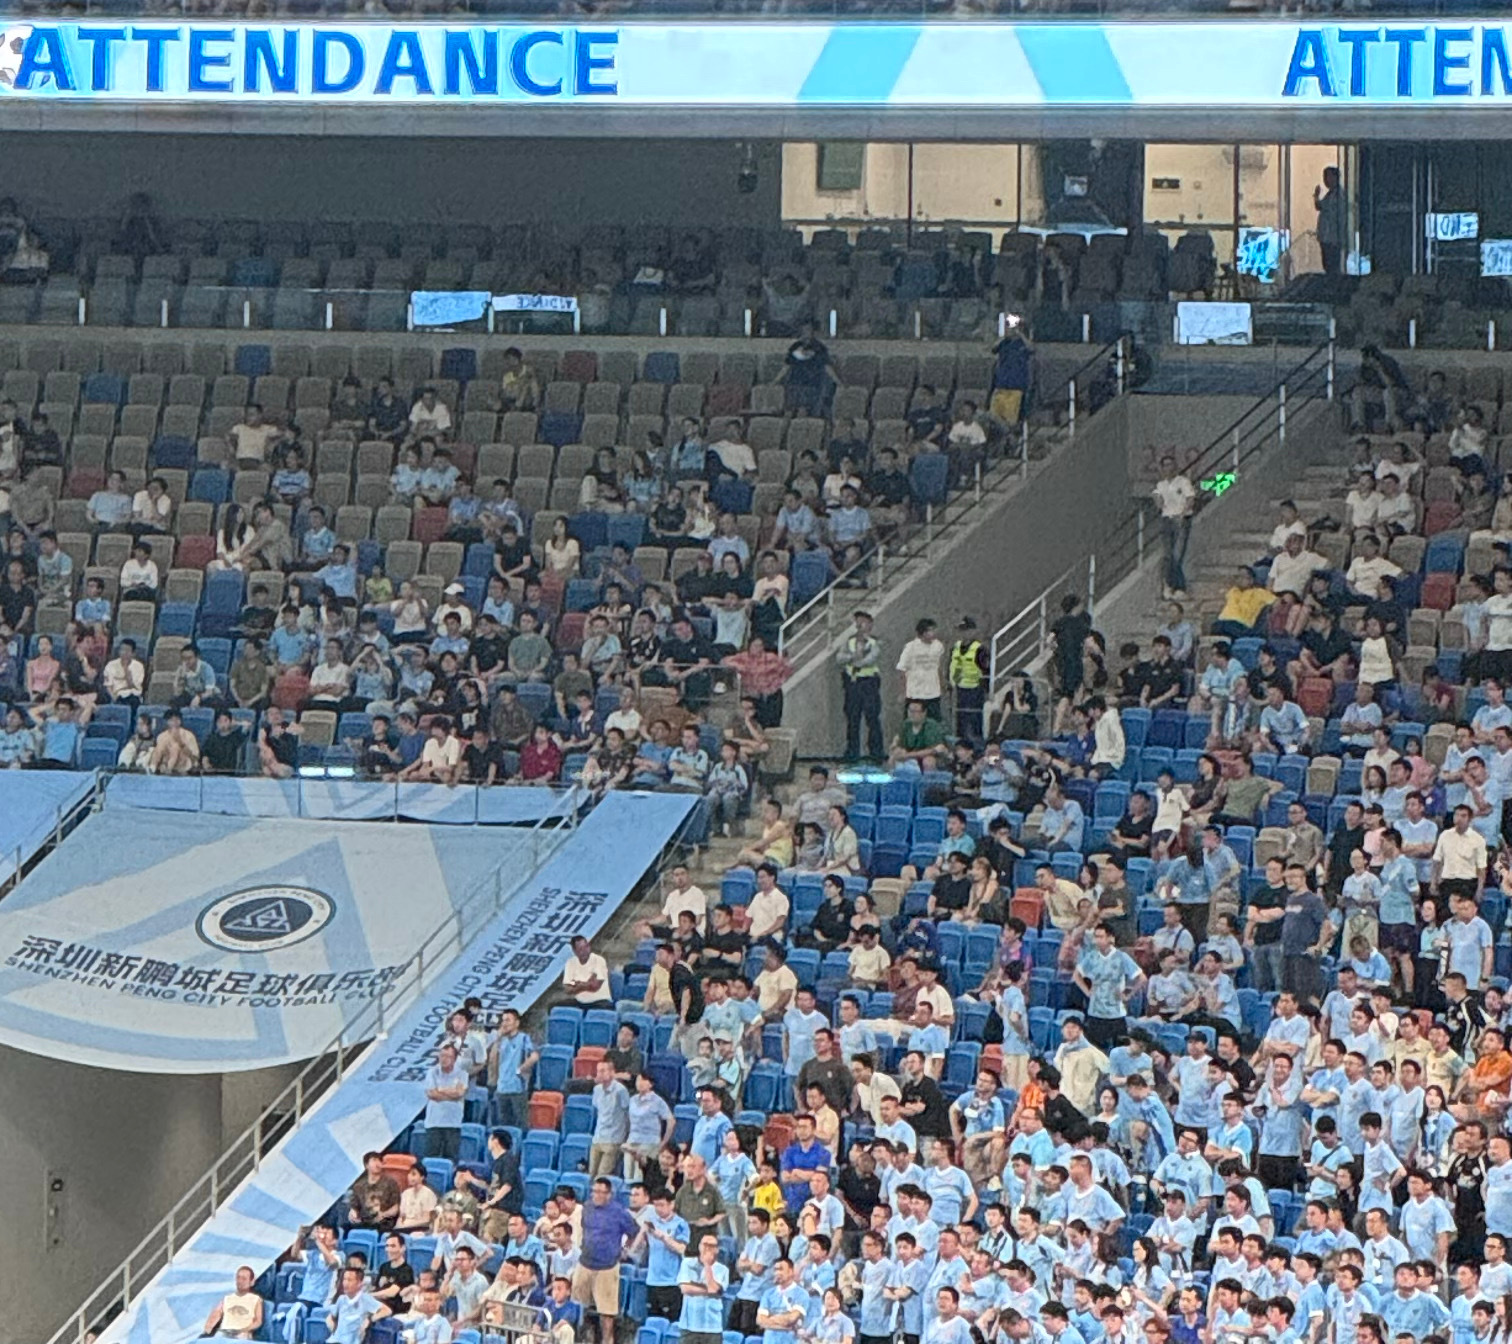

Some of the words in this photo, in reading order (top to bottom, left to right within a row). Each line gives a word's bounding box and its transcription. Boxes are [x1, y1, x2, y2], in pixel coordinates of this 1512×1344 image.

[14, 26, 619, 96] ATTENDANCE
[498, 886, 562, 946] SHENZHEN
[4, 956, 116, 990] SHENZHEN
[120, 982, 177, 1000] PENG
[183, 991, 231, 1006] CITY
[471, 943, 511, 975] PENG
[447, 974, 482, 1001] CITY
[394, 999, 459, 1055] FOOTBALL
